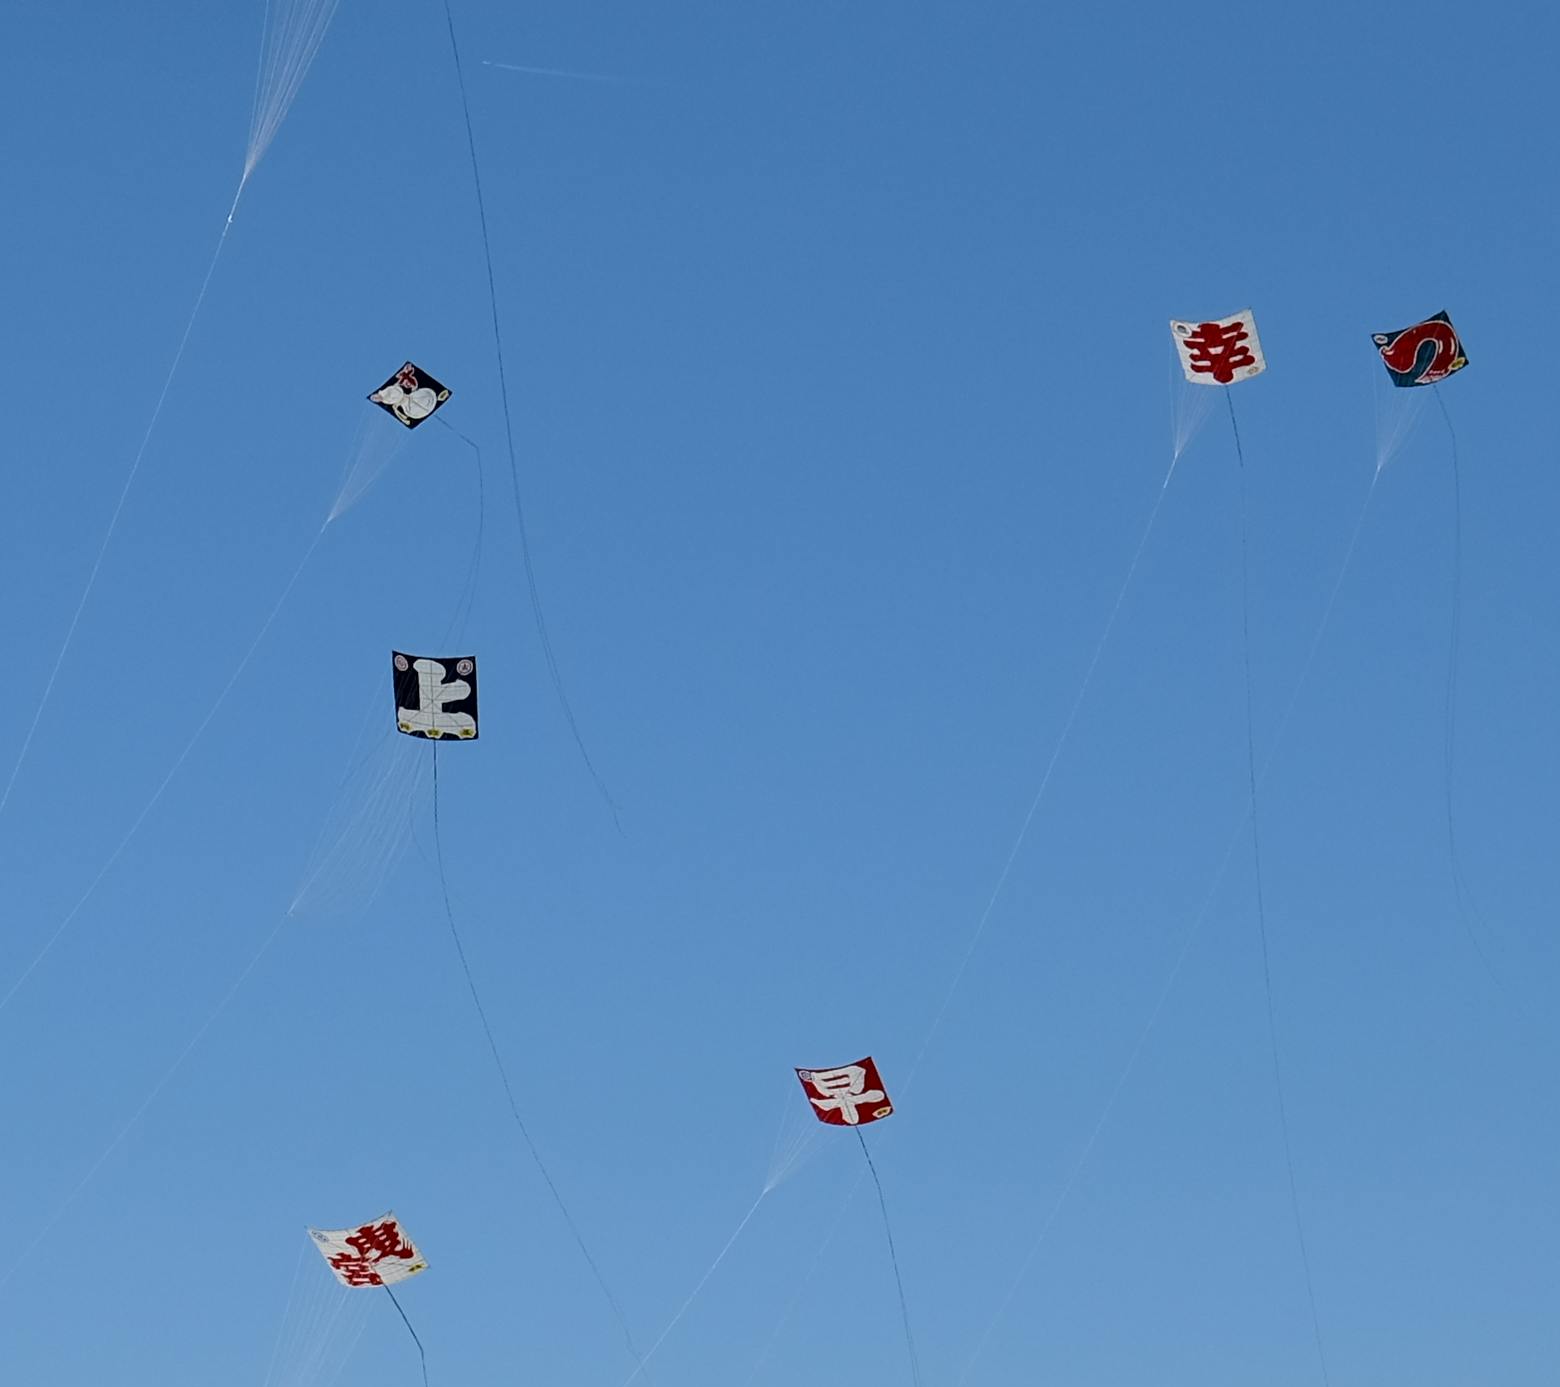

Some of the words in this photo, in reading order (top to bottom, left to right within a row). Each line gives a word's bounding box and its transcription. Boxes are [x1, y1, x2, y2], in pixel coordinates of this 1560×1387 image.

[1183, 322, 1255, 384] 幸
[397, 661, 477, 733] 上
[810, 1064, 885, 1125] 早
